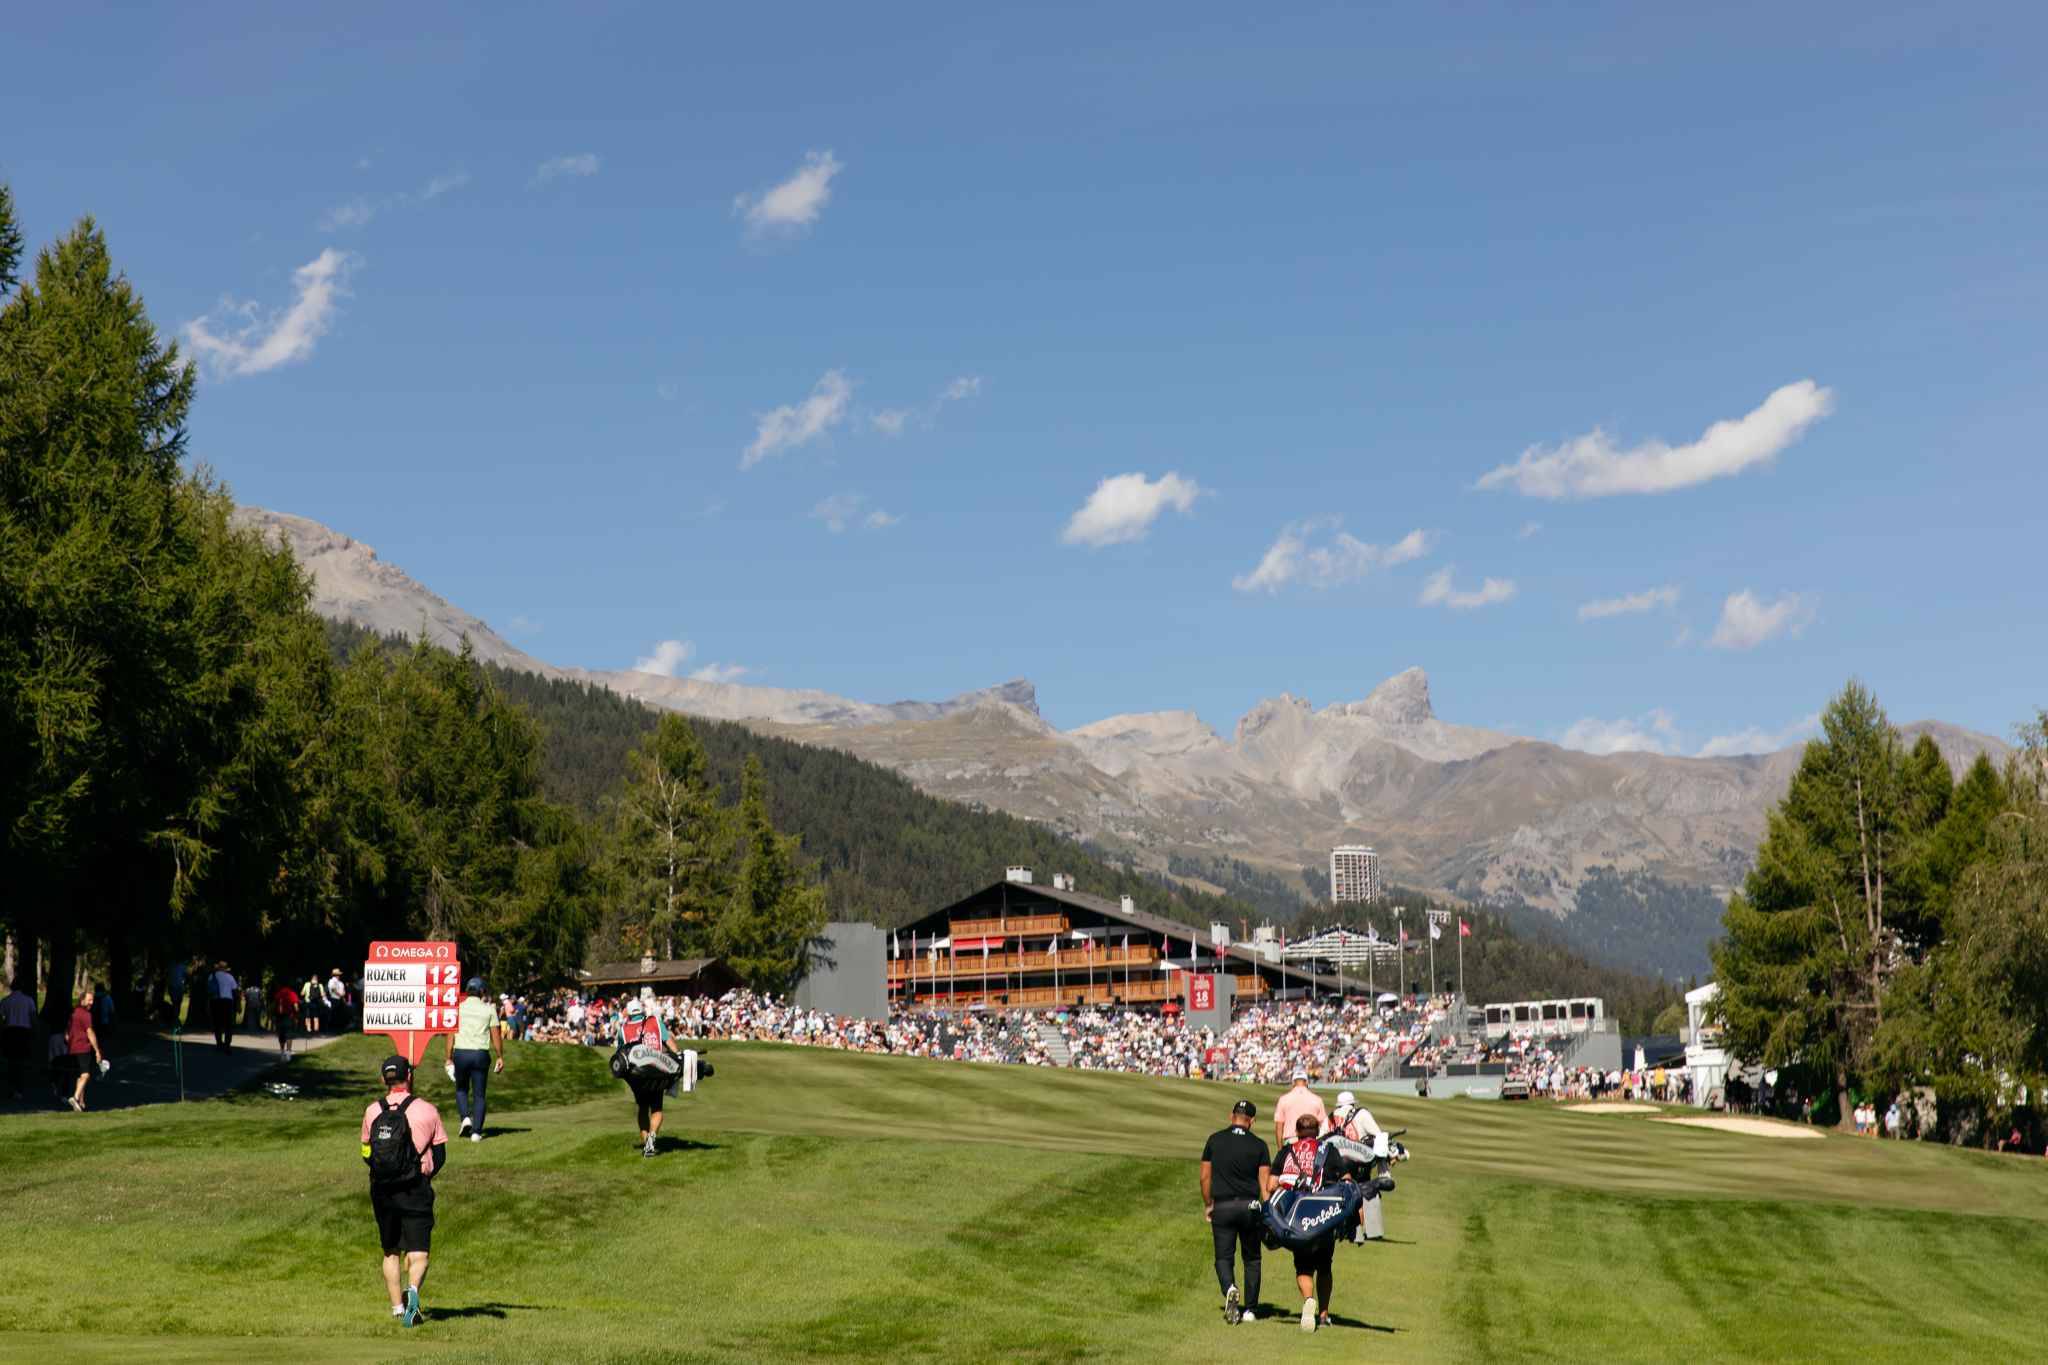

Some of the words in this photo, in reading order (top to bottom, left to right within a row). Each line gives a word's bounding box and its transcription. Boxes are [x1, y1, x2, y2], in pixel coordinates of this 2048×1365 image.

[391, 947, 434, 958] OMEGA
[366, 968, 406, 981] ROZNER
[430, 964, 458, 985] 12
[419, 991, 426, 1003] R
[429, 987, 457, 1006] 14
[1196, 990, 1209, 1002] 18
[366, 1012, 413, 1025] WALLACE
[428, 1008, 457, 1028] 15
[1301, 1202, 1342, 1231] Penfold
